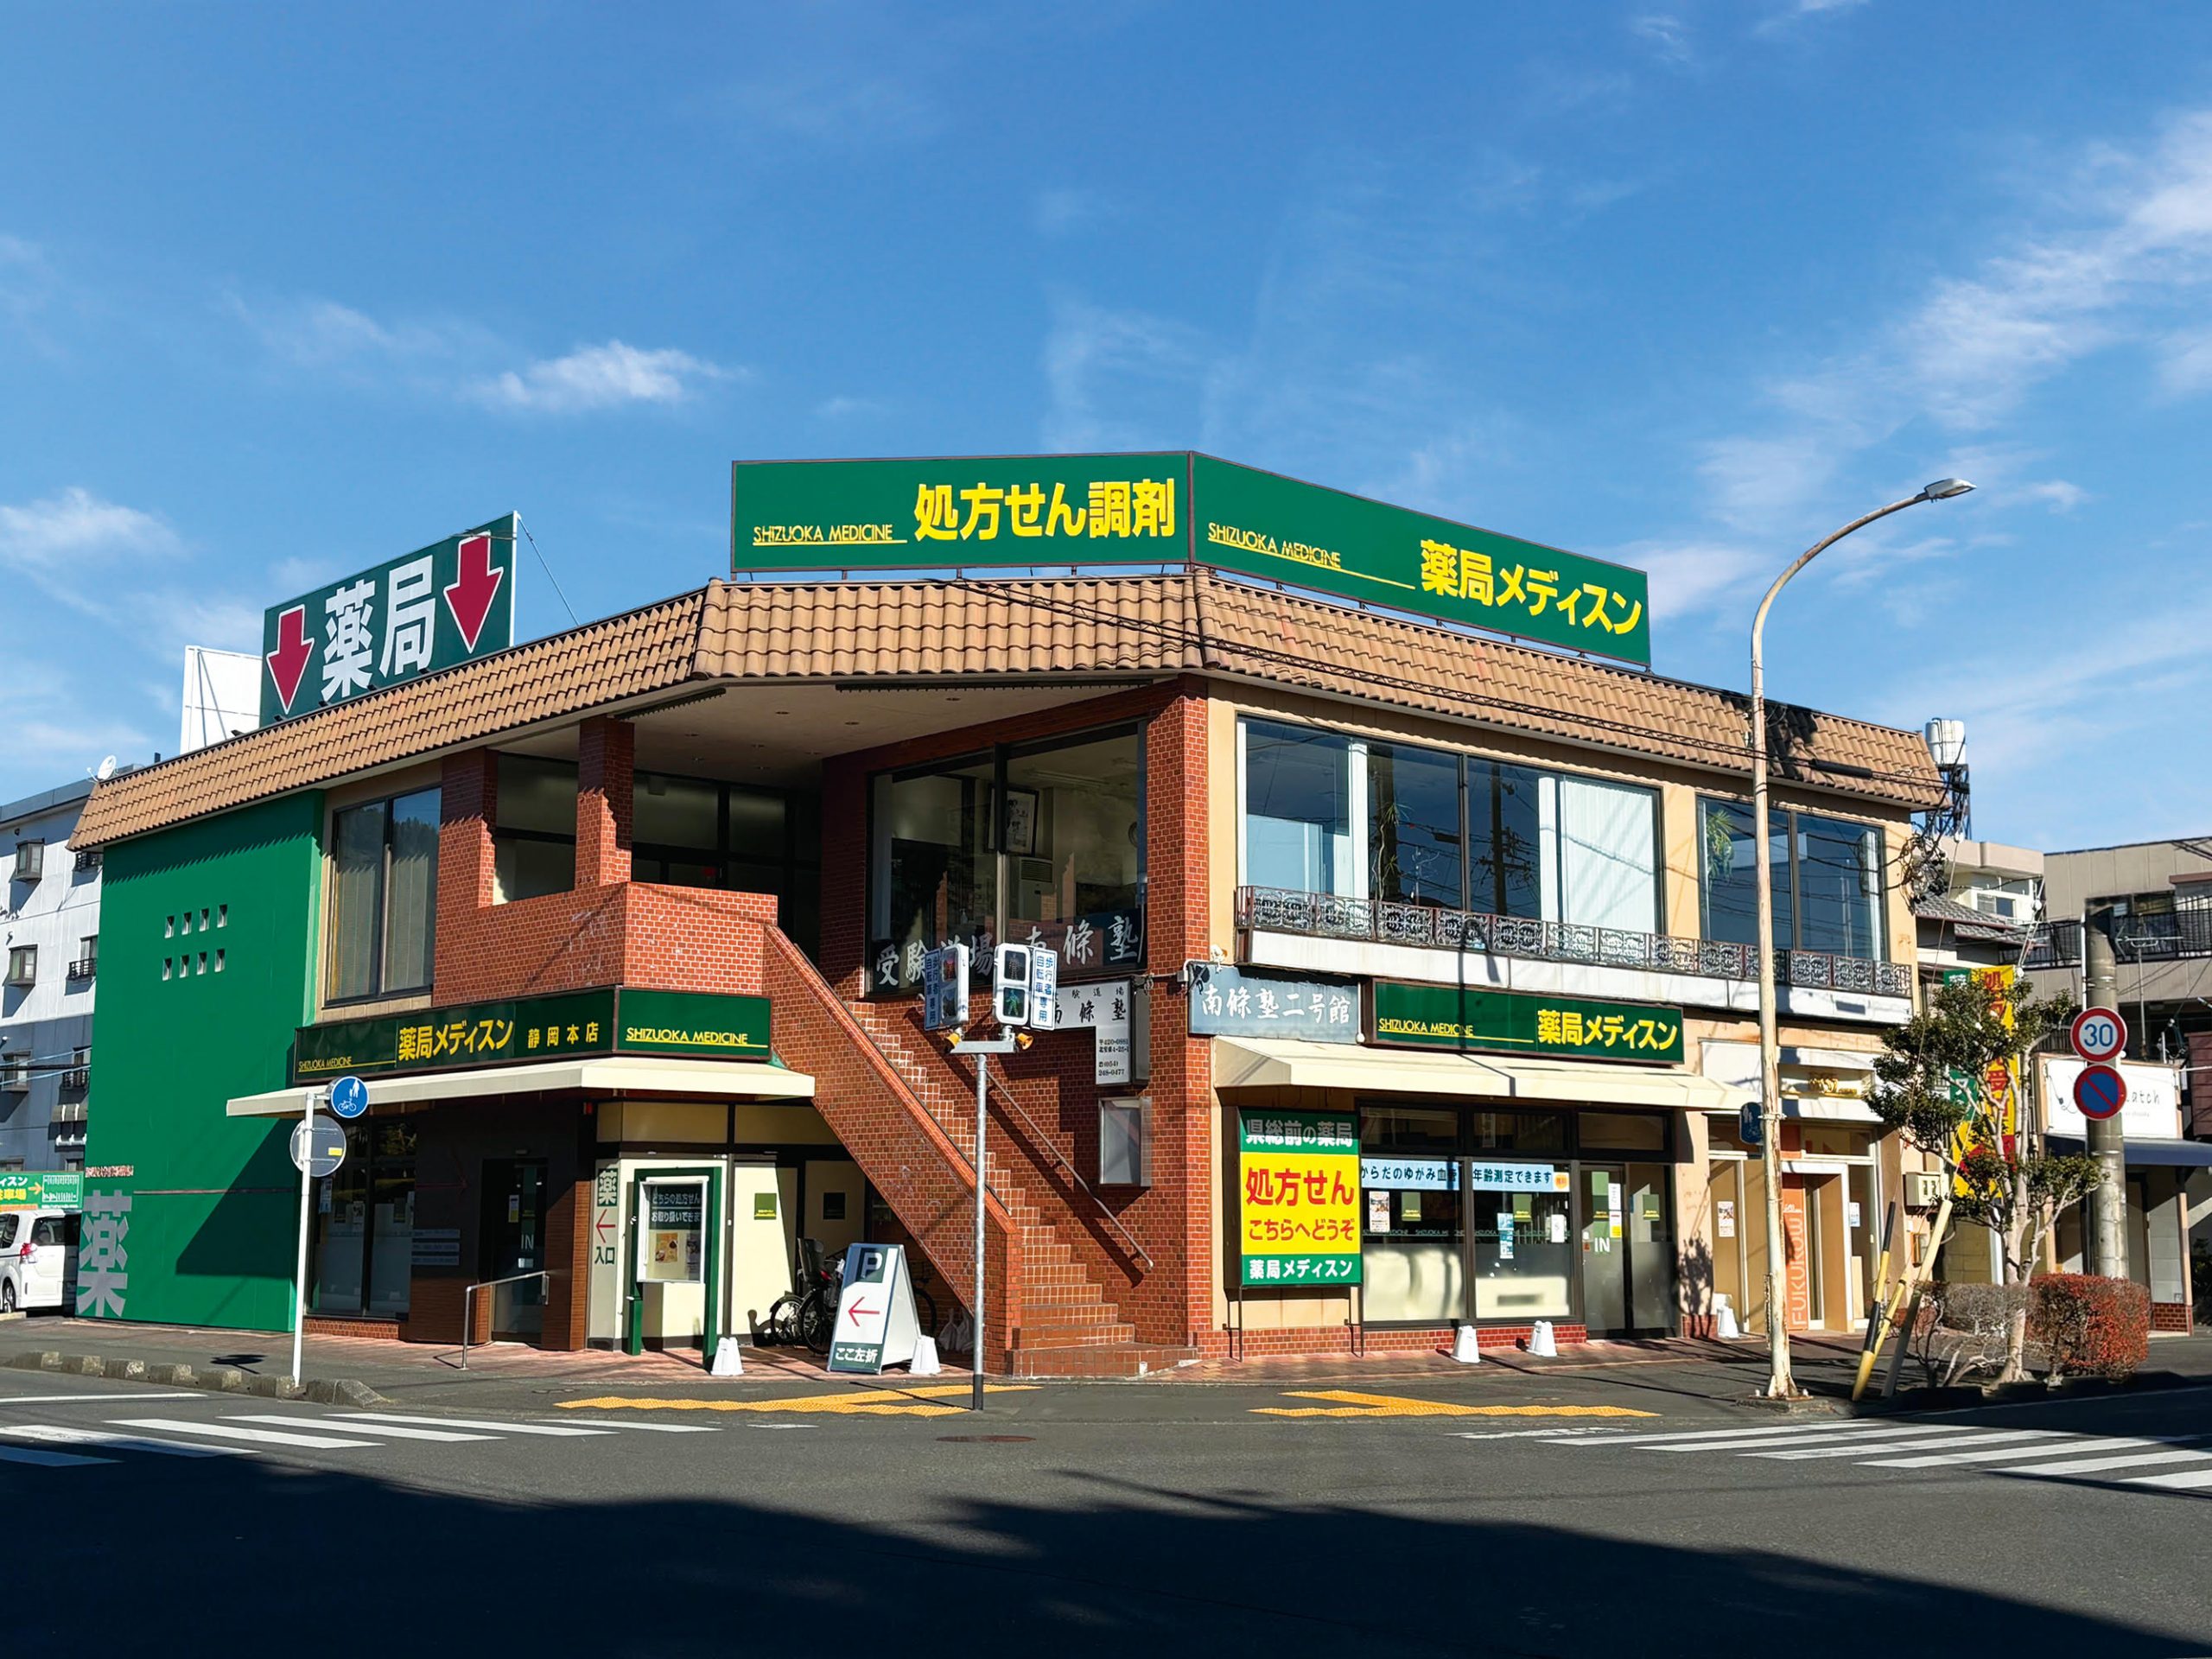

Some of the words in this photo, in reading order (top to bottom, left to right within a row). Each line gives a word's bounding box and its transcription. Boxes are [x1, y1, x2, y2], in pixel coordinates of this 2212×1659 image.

[914, 478, 1175, 541] 処方せん調剤
[753, 525, 823, 543] SHIZUOKA
[829, 524, 893, 542] MEDICINE
[1208, 522, 1277, 554] SHIZUOKA
[1281, 541, 1342, 569] MEDICINE
[1420, 538, 1643, 635] 薬局メディスン
[321, 554, 437, 702] 薬局
[875, 931, 995, 987] 受験場
[1202, 983, 1351, 1025] 南條塾二号館
[626, 1027, 690, 1042] SHIZUOKA
[692, 1030, 748, 1045] MEDICINE
[1378, 1018, 1428, 1033] SHIZUOKA
[1430, 1021, 1474, 1037] MEDICINE
[1537, 1009, 1678, 1051] 薬局メディスン
[2083, 1023, 2113, 1047] 30
[397, 1020, 514, 1061] 薬局メディスン
[528, 1022, 600, 1050] 静岡本店
[298, 1059, 325, 1071] SHIZUOKA
[326, 1056, 353, 1067] MEDICINE
[2126, 1090, 2160, 1105] atch
[598, 1170, 618, 1205] 薬
[1245, 1167, 1355, 1207] 処方せん
[521, 1234, 534, 1250] IN
[1249, 1218, 1356, 1242] こちらへどうぞ
[74, 1188, 132, 1319] 薬
[594, 1246, 615, 1265] 入口
[1594, 1236, 1611, 1253] IN
[861, 1252, 883, 1279] P
[1249, 1259, 1353, 1280] 薬局メディスン
[835, 1347, 879, 1363] ここ左折
